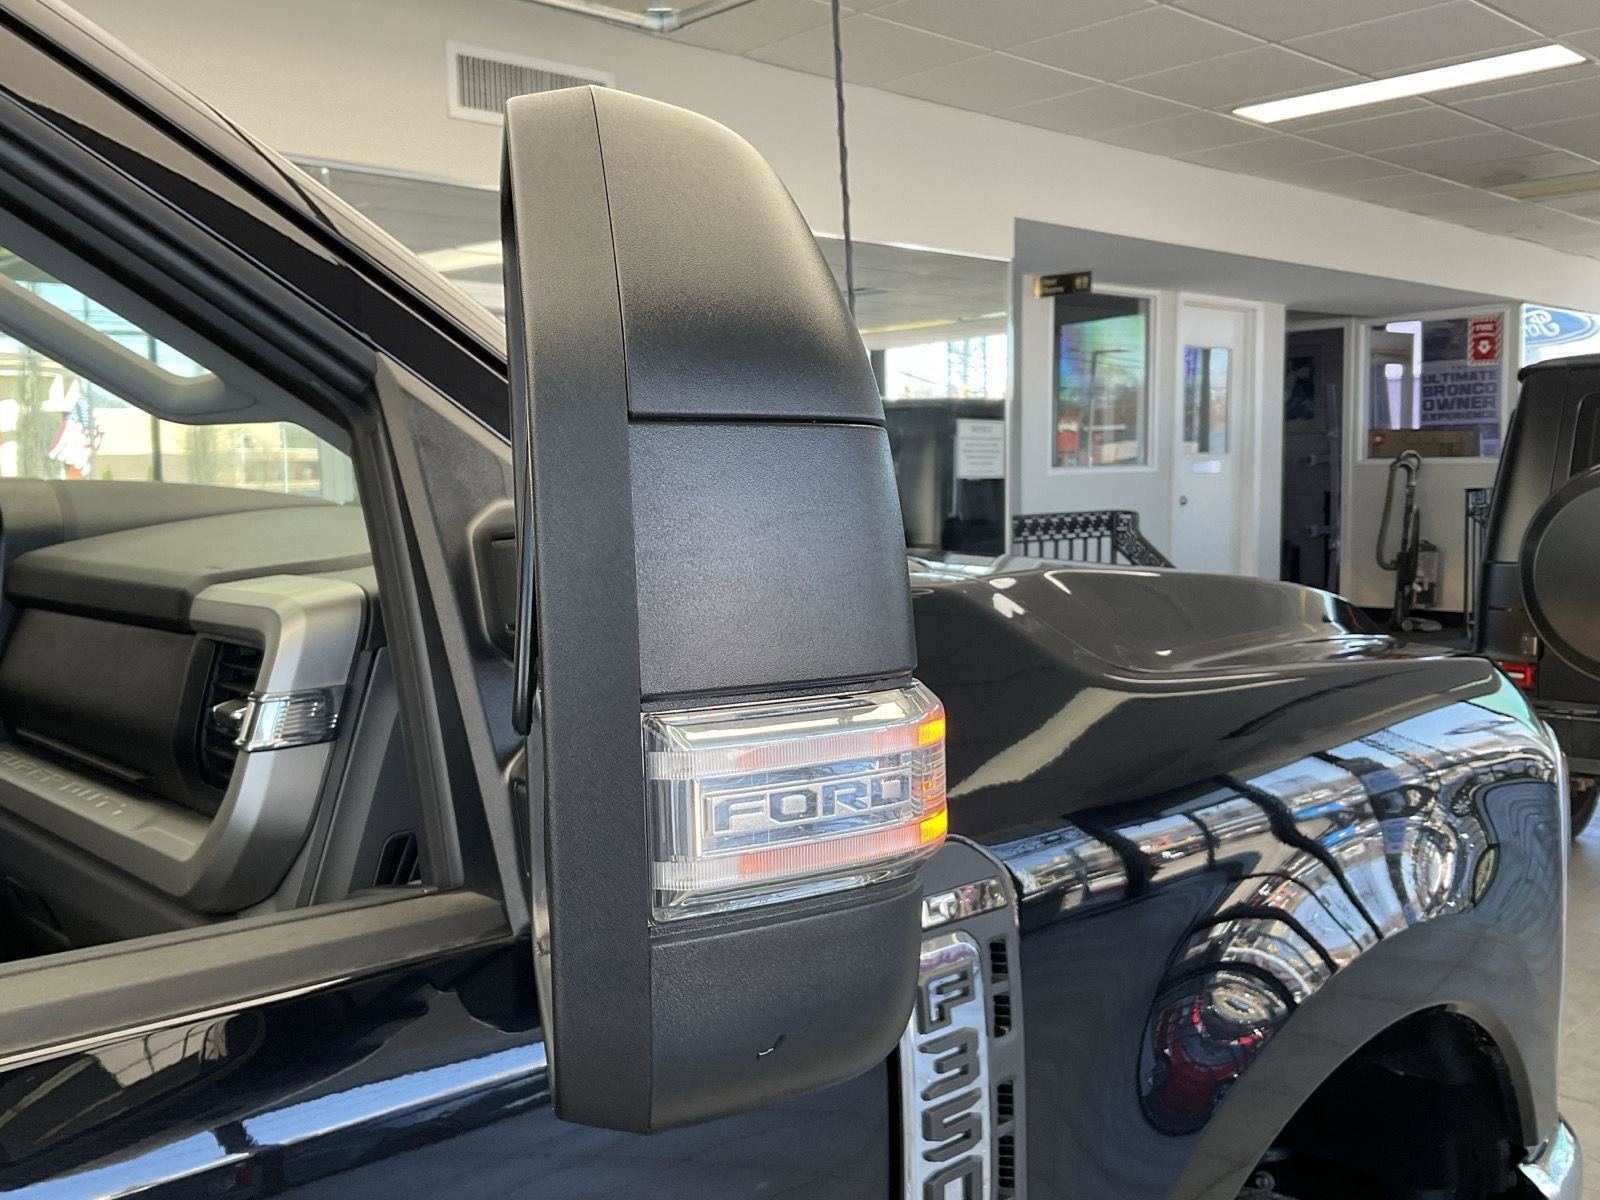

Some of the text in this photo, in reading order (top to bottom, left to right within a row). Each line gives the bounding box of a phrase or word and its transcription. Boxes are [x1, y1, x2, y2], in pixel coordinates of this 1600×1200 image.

[1422, 370, 1498, 384] ULTIMATE
[1422, 383, 1497, 397] BRONCO
[1423, 396, 1496, 411] OWNER
[1422, 411, 1497, 421] EXPERIENCE
[714, 767, 912, 832] FORD
